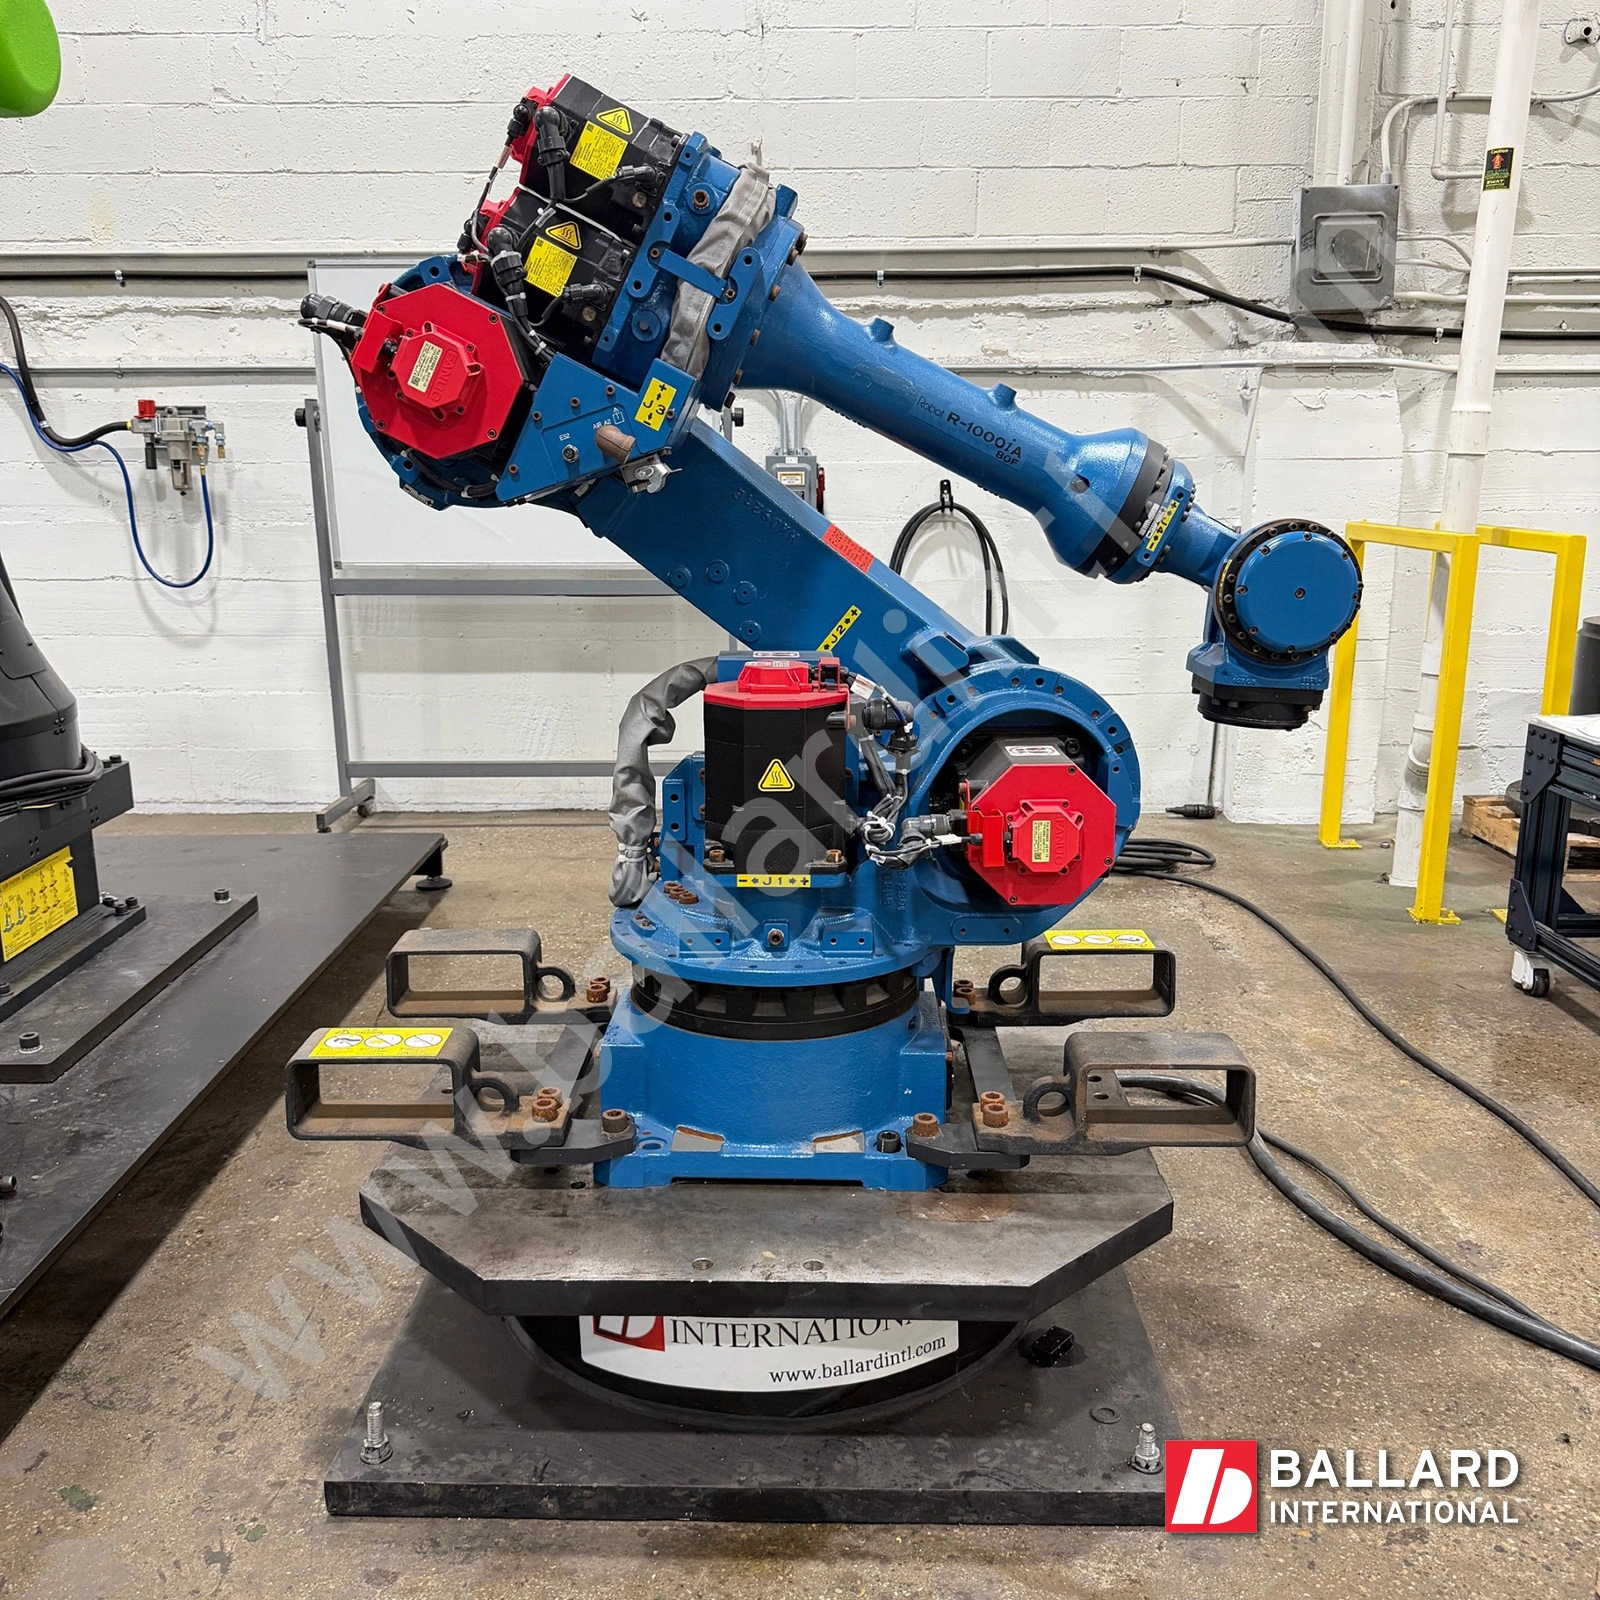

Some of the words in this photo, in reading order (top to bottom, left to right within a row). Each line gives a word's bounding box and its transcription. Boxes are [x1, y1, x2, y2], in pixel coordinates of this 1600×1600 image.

[917, 396, 945, 418] Robot
[947, 411, 1022, 458] R-1000iA
[995, 451, 1019, 466] 80F
[831, 625, 846, 644] J2
[762, 876, 782, 886] J1
[768, 1336, 947, 1383] www.ballardintl.com
